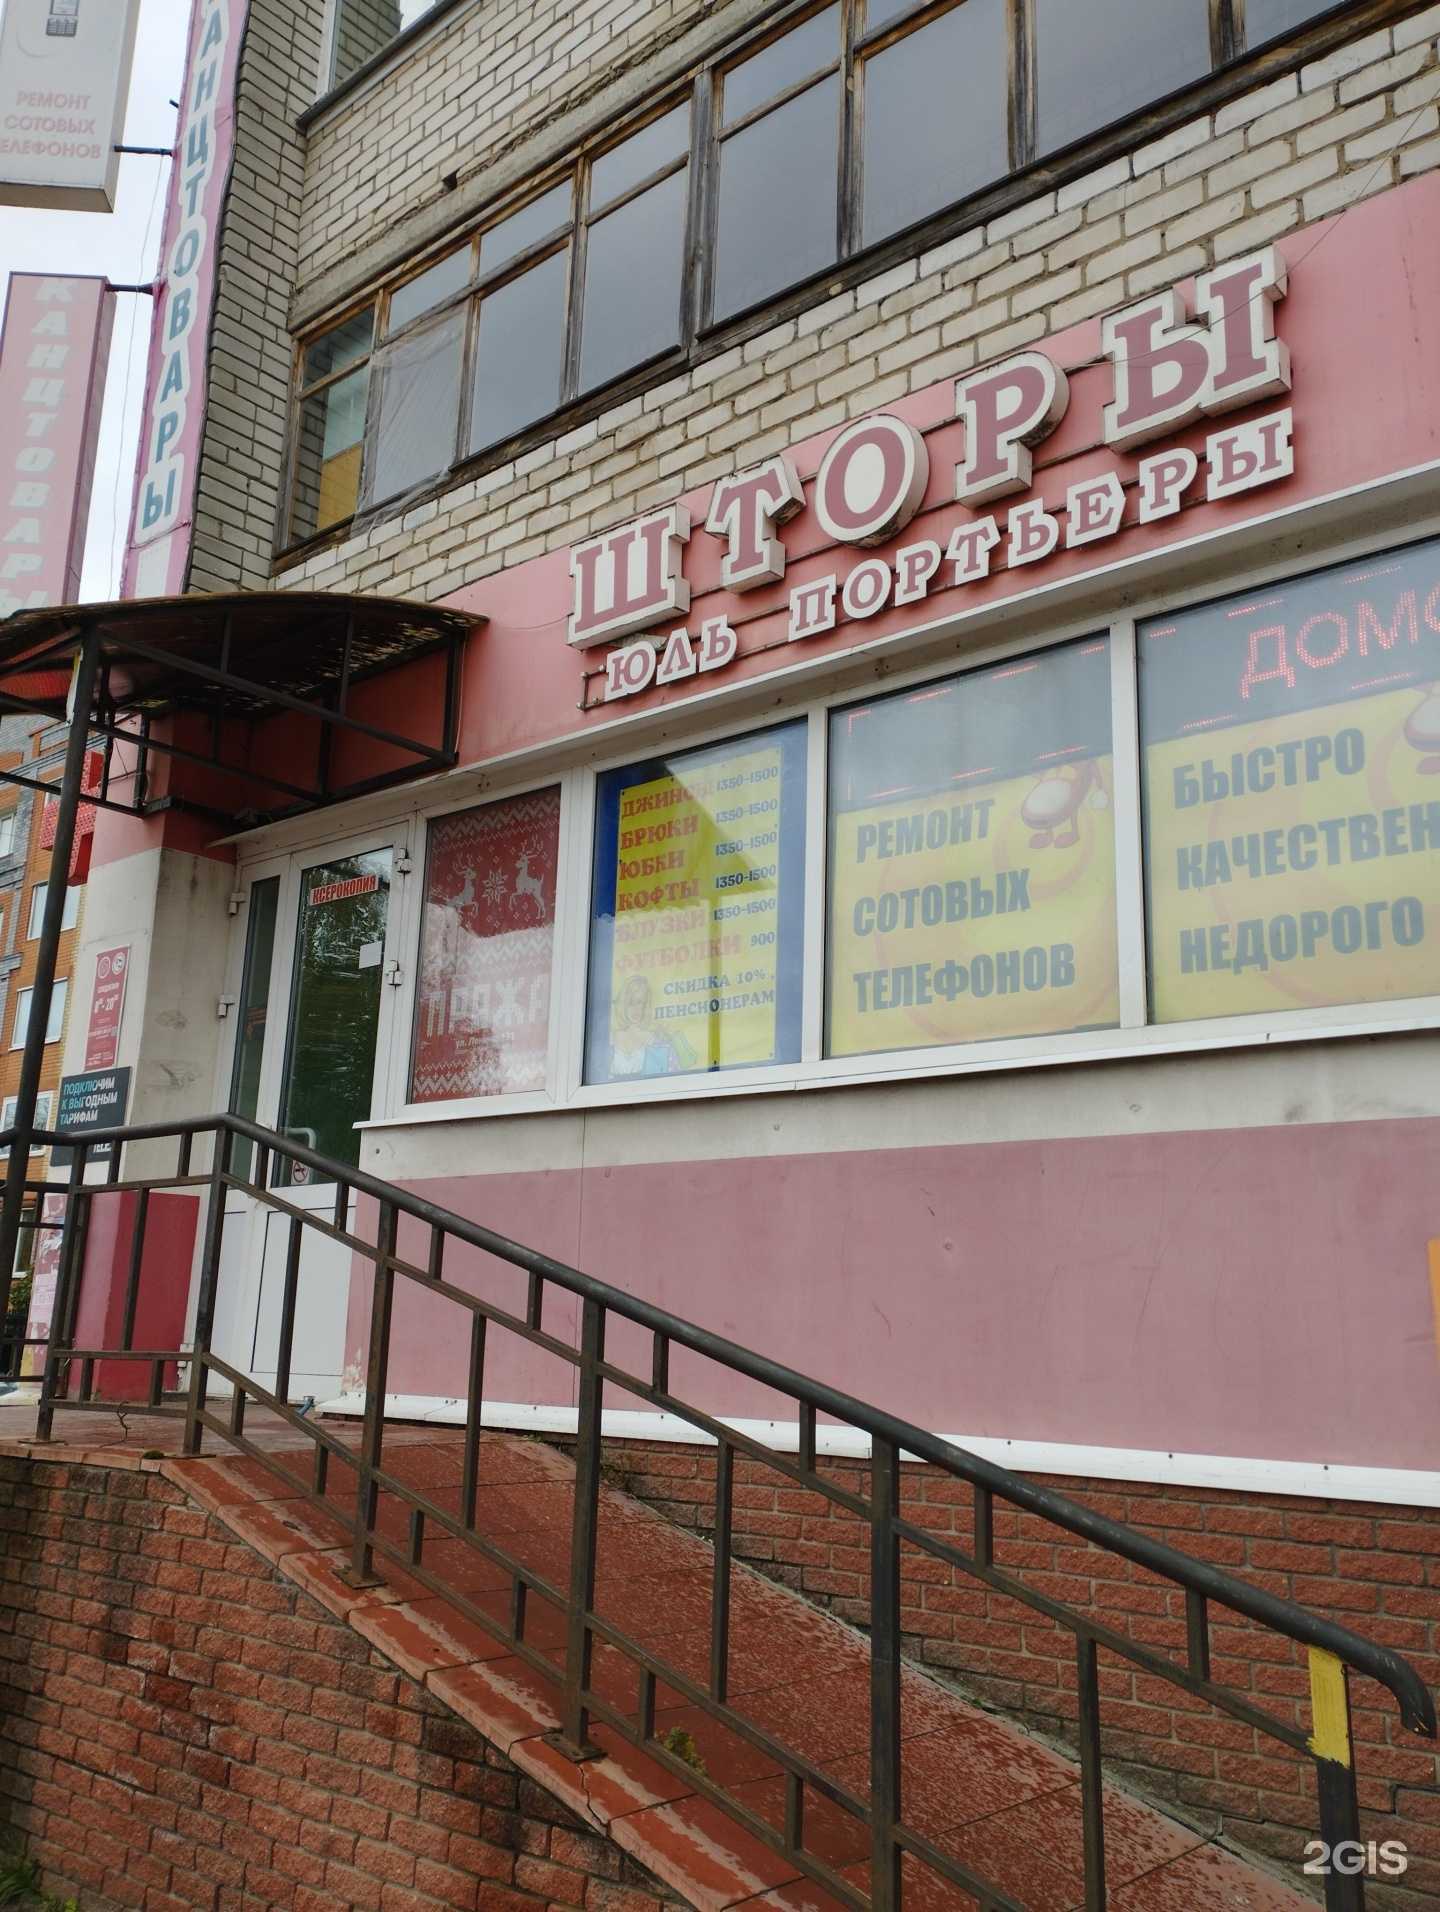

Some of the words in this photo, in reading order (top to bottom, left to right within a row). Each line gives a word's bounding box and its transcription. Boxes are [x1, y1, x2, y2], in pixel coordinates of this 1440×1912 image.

[4, 114, 96, 135] СОТОВЫХ
[16, 90, 91, 111] РЕМОНТ
[142, 0, 222, 531] АНЦТОВАРЫ
[569, 248, 1288, 645] ШТОРЫ
[606, 616, 737, 700] ЮЛЬ
[789, 409, 1293, 641] ПОРТЬЕРЫ
[716, 766, 778, 791] 1350-1500
[1173, 727, 1366, 810] БЫСТРО
[620, 815, 699, 850] БРЮКИ
[715, 799, 778, 823] 1350-1500
[856, 800, 995, 864] РЕМОНТ
[1176, 801, 1440, 891] КАЧЕСТВЕН
[618, 850, 685, 881] ЮБКИ
[715, 831, 777, 856] 1350-1500
[312, 875, 377, 905] КСЕРОКОПИЯ
[617, 878, 700, 912] КОФТЫ
[714, 864, 776, 889] 1350-1500
[713, 898, 776, 921] 1350-1500
[853, 868, 1031, 937] СОТОВЫХ
[751, 931, 775, 947] 900
[1180, 896, 1425, 975] НЕДОРОГО
[663, 976, 730, 996] СКИДКА
[853, 943, 1076, 1013] ТЕЛЕФОНОВ
[654, 990, 774, 1020] ПЕНСИОНЕРАМ
[61, 1099, 67, 1110] К
[69, 1092, 118, 1109] ВЫГОДНЫМ
[63, 1077, 115, 1096] ПОДКЛЮЧИМ
[60, 1109, 98, 1125] ТАРИФАМ
